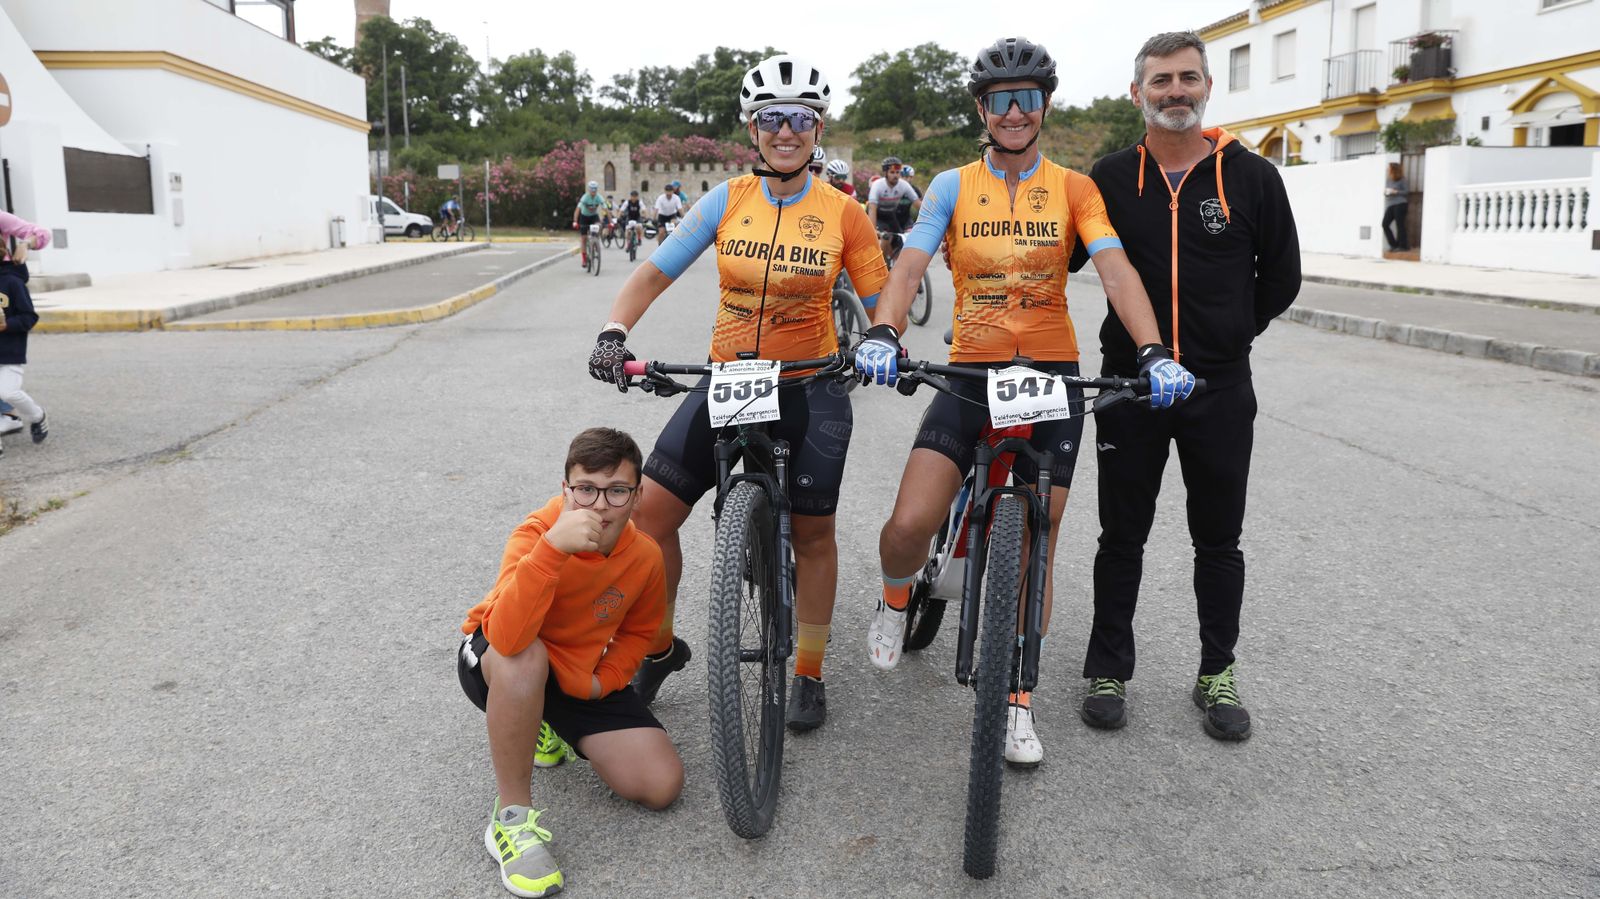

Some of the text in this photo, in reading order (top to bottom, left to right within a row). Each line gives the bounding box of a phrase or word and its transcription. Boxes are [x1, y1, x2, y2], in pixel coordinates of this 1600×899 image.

[963, 220, 1059, 239] LOCURA BIKE
[720, 239, 829, 267] LOCURA BIKE
[1014, 238, 1059, 247] SAN FERNANDO
[772, 263, 825, 277] SAN FERNANDO
[713, 376, 774, 403] 535
[996, 377, 1056, 402] 547
[747, 409, 778, 417] emergencias
[994, 413, 1021, 421] Teléfonos
[1032, 407, 1067, 415] emergencias
[939, 432, 967, 459] BIKE
[658, 463, 690, 489] BIKE
